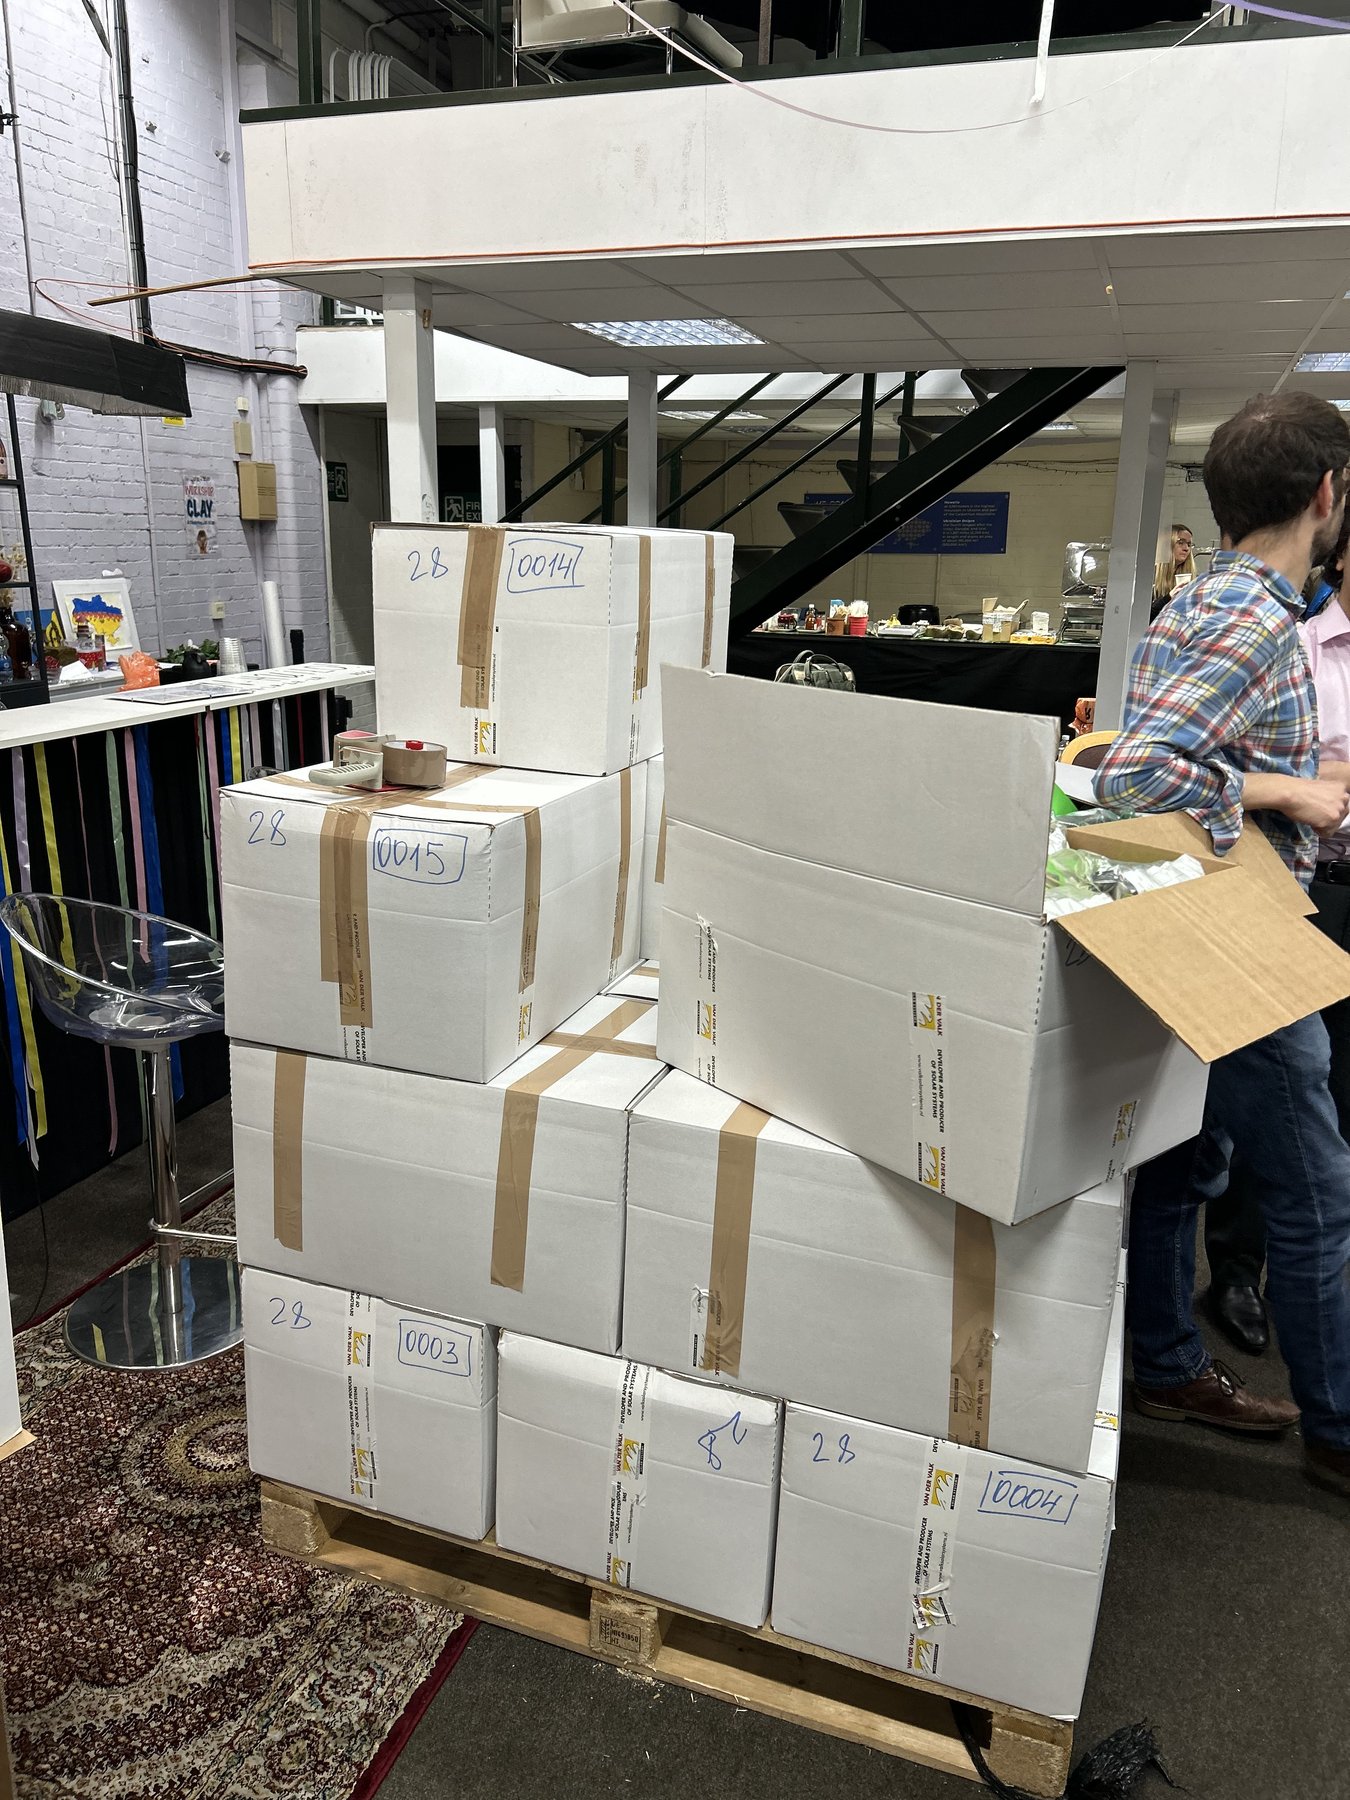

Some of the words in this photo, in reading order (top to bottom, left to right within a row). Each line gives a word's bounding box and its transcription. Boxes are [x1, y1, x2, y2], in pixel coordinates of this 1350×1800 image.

[187, 498, 213, 518] CLAY
[466, 502, 480, 510] FIR
[466, 512, 480, 520] EXI
[408, 546, 448, 581] 28
[518, 553, 573, 580] 0014
[248, 810, 286, 846] 28
[377, 836, 445, 876] 0015
[270, 1297, 312, 1330] 28
[406, 1330, 459, 1364] 0003
[630, 1364, 638, 1390] SYSTEMS
[812, 1432, 856, 1464] 28
[992, 1480, 1062, 1515] 0004
[914, 1556, 922, 1584] DEVELOPER
[919, 1517, 928, 1544] PRODUCER
